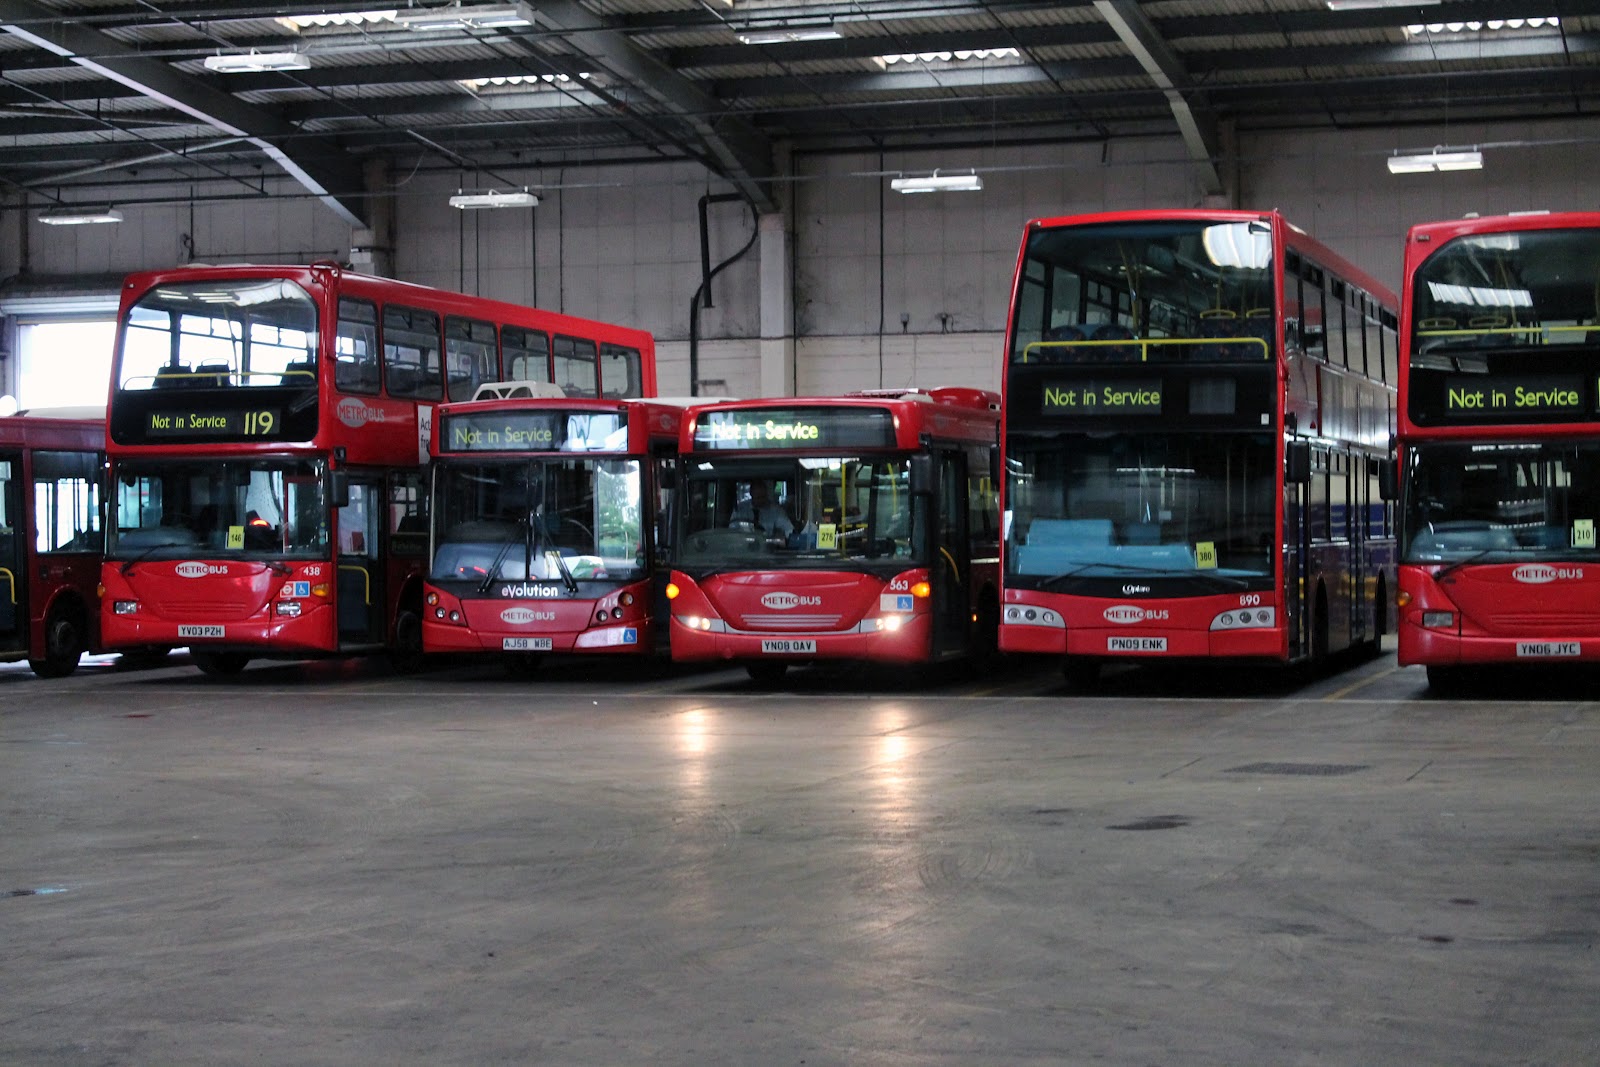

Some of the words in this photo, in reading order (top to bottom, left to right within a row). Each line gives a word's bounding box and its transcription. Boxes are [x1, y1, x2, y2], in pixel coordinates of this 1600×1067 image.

[1045, 387, 1076, 406] Not
[1083, 389, 1096, 405] in
[1103, 386, 1160, 406] Service
[1449, 388, 1485, 409] Not
[1492, 389, 1507, 407] in
[1515, 386, 1579, 407] Service
[338, 404, 385, 422] METROBUS
[151, 414, 171, 429] Not
[175, 416, 185, 428] in
[189, 413, 227, 428] Service
[243, 411, 274, 435] 119
[455, 427, 482, 445] Not
[487, 429, 499, 443] in
[504, 426, 552, 443] Service
[711, 421, 742, 440] Not
[746, 422, 760, 439] in
[765, 420, 819, 440] Service
[1577, 529, 1591, 540] 210
[176, 565, 229, 575] METROBUS
[303, 567, 321, 576] 438
[1514, 568, 1584, 580] METROBUS
[889, 578, 909, 591] 563
[762, 596, 822, 605] METROBUS
[1239, 594, 1260, 606] 890
[502, 611, 556, 621] METROBUS
[1104, 609, 1169, 620] METROBUS
[181, 626, 203, 636] YV03
[204, 626, 222, 636] PZH
[764, 641, 790, 651] YN08
[1111, 638, 1140, 649] PN09
[1142, 638, 1163, 649] ENK
[1554, 642, 1577, 655] JYC
